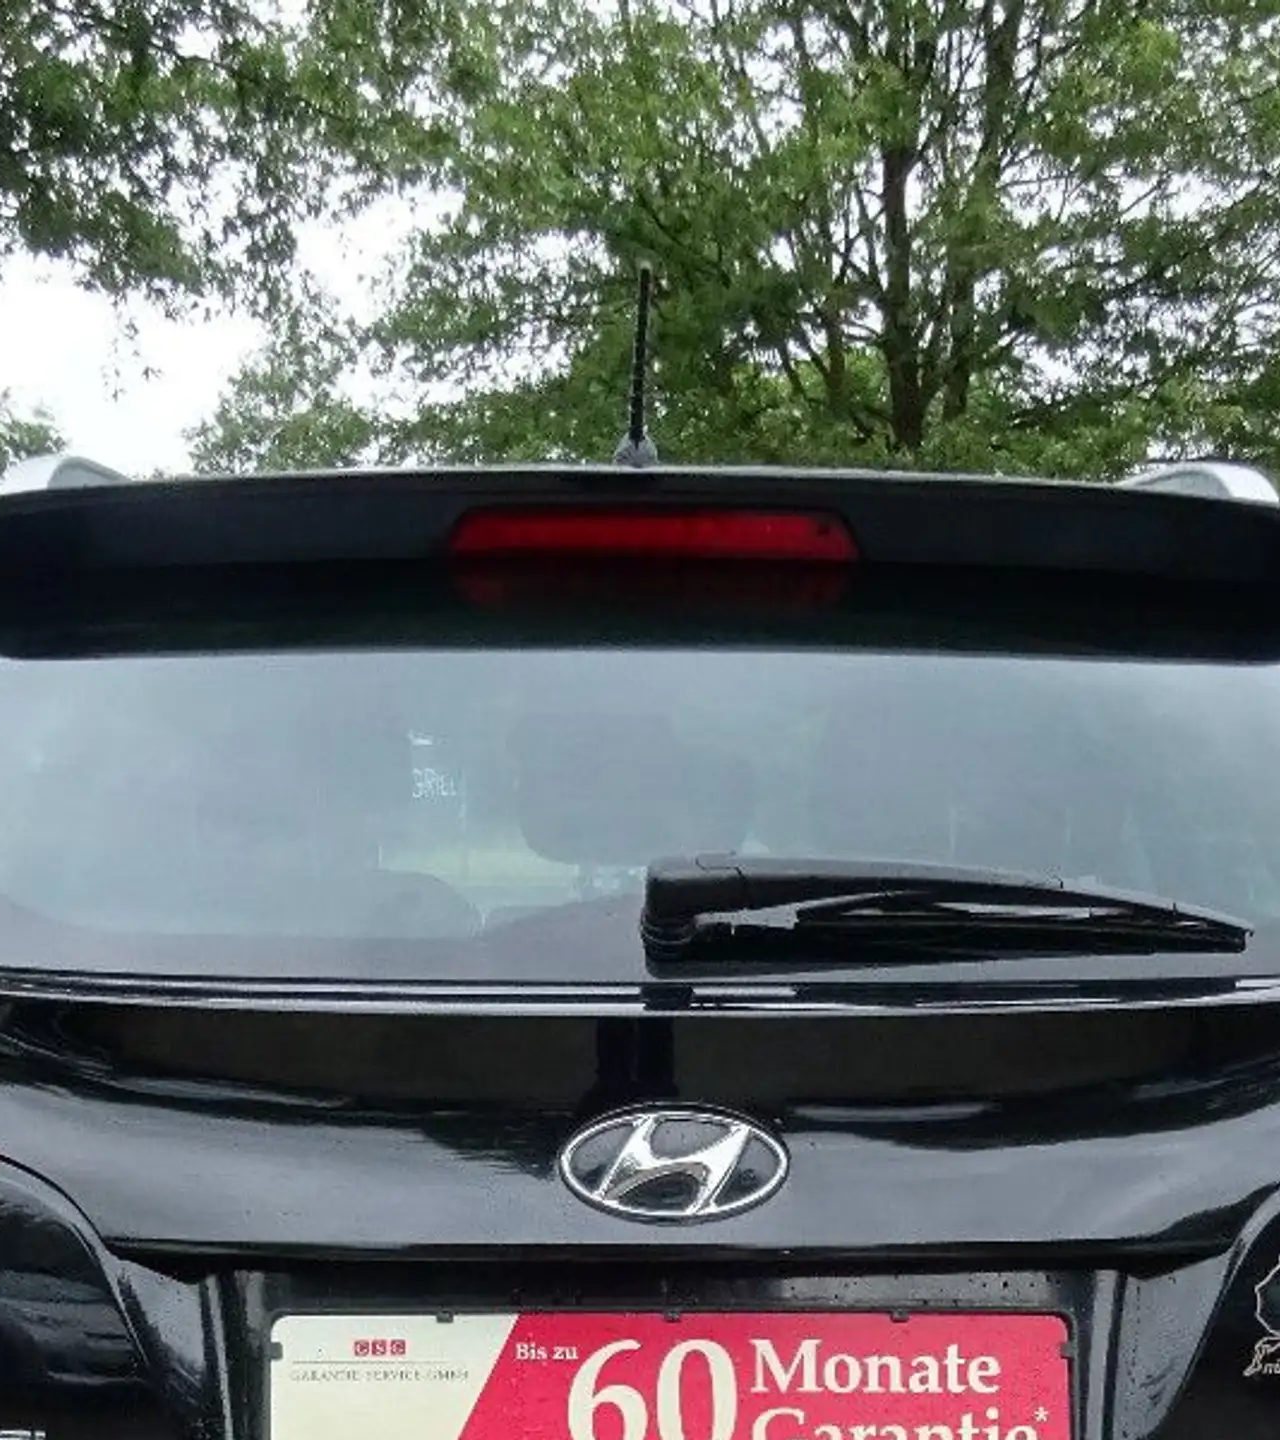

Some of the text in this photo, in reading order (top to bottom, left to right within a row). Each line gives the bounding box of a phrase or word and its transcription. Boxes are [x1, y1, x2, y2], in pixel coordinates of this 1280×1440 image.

[515, 1343, 578, 1361] Bis zu
[750, 1338, 1001, 1394] Monate
